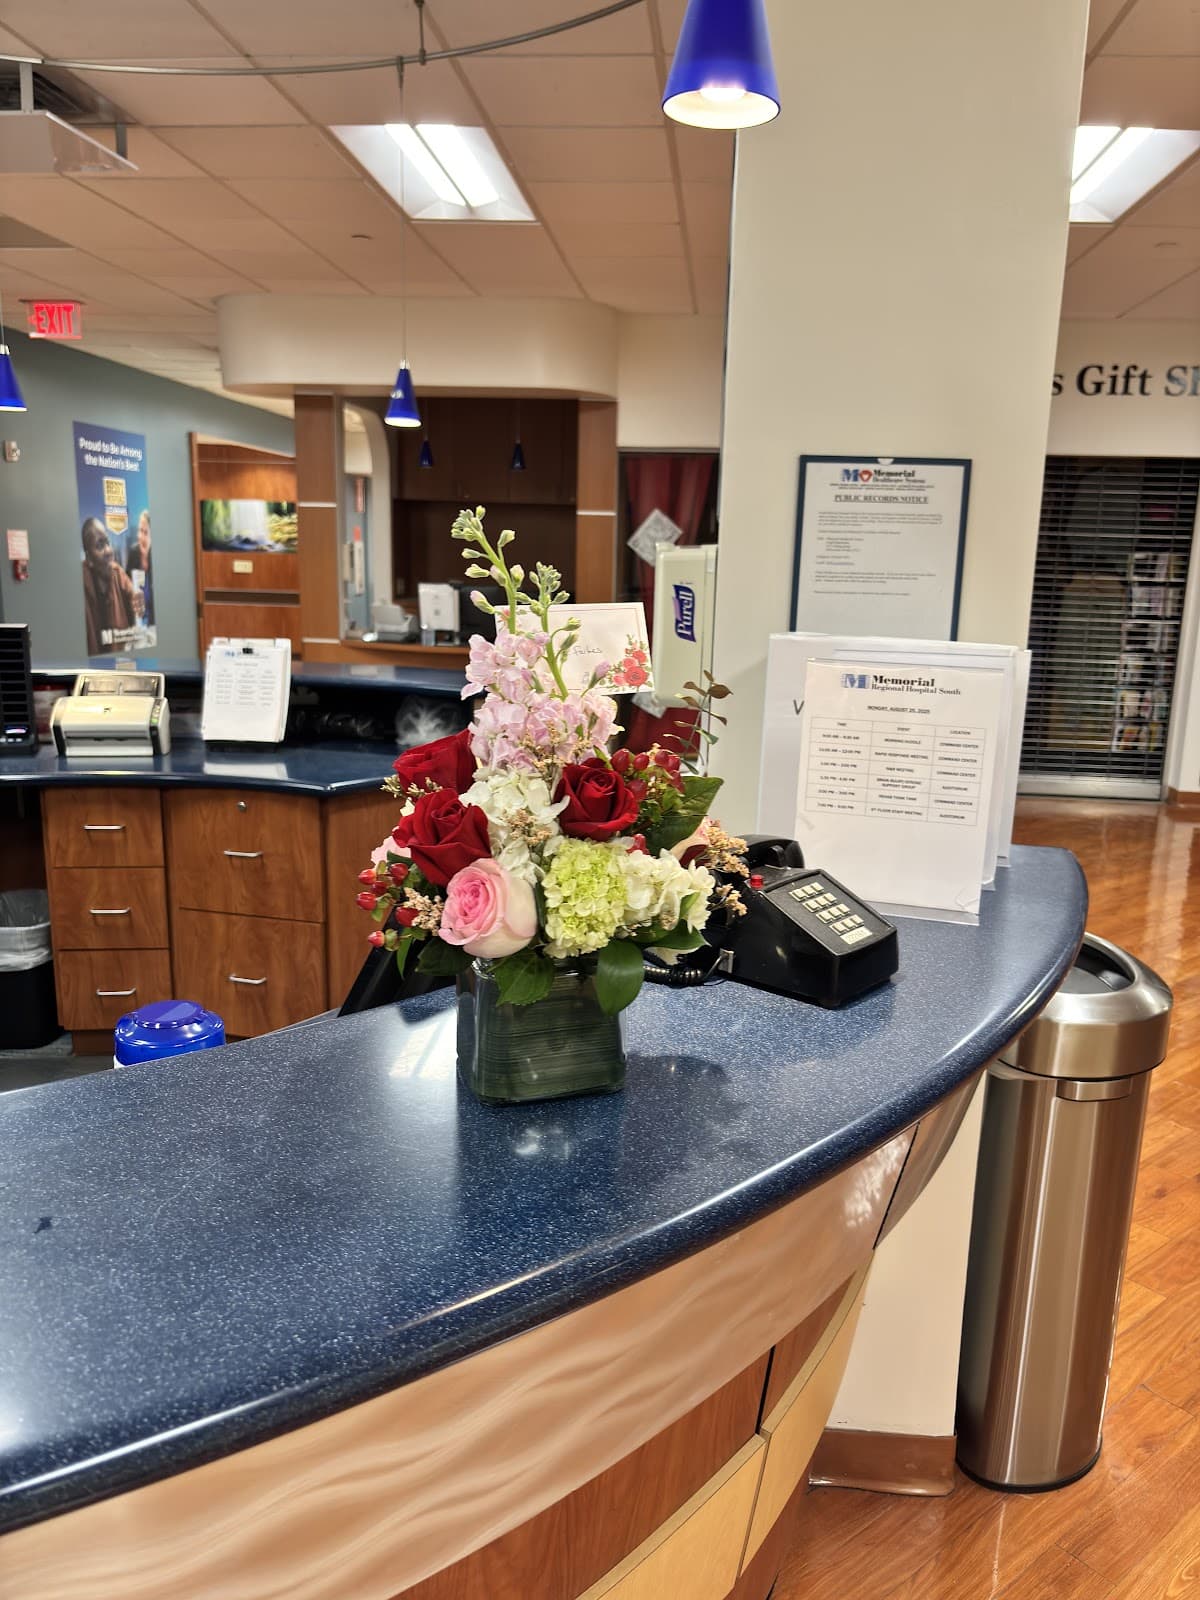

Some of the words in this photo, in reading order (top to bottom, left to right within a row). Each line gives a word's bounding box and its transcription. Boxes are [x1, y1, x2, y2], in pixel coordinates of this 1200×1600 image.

[35, 304, 74, 334] EXIT
[1076, 364, 1152, 396] Gift
[79, 437, 101, 452] Proud
[120, 444, 142, 461] Among
[84, 453, 98, 466] the
[873, 469, 915, 478] Memorial
[835, 494, 860, 503] PUBLIC
[863, 495, 898, 504] RECORDS
[900, 496, 928, 504] NOTICE
[677, 590, 693, 635] Purell
[872, 674, 935, 687] Memorial
[871, 683, 905, 692] Regional
[906, 686, 937, 695] Hospital
